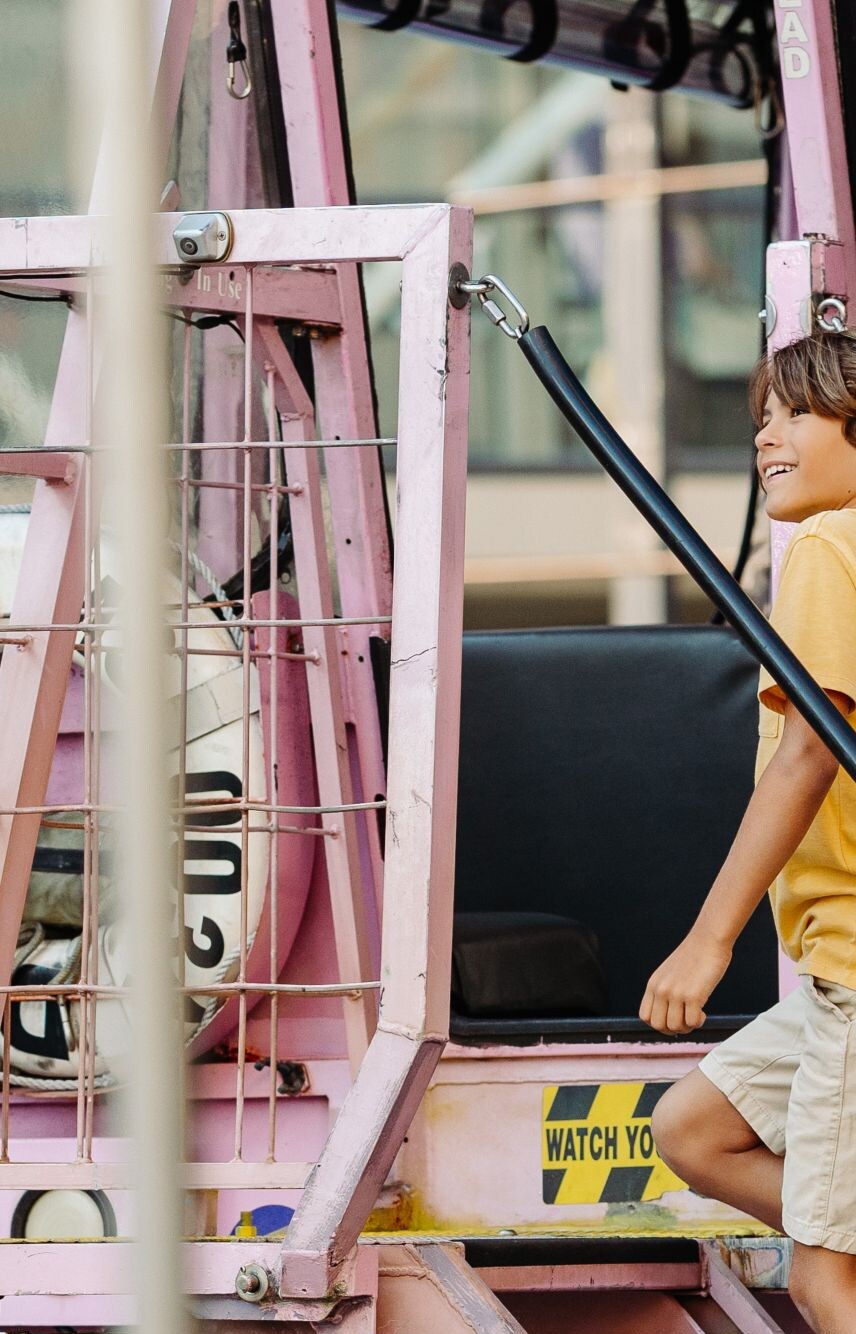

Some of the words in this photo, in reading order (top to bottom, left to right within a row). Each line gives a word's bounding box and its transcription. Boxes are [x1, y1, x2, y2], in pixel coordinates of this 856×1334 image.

[779, 0, 811, 79] AD
[197, 267, 211, 292] In
[218, 272, 242, 300] Use
[545, 1126, 618, 1162] WATCH
[625, 1124, 660, 1160] YO
